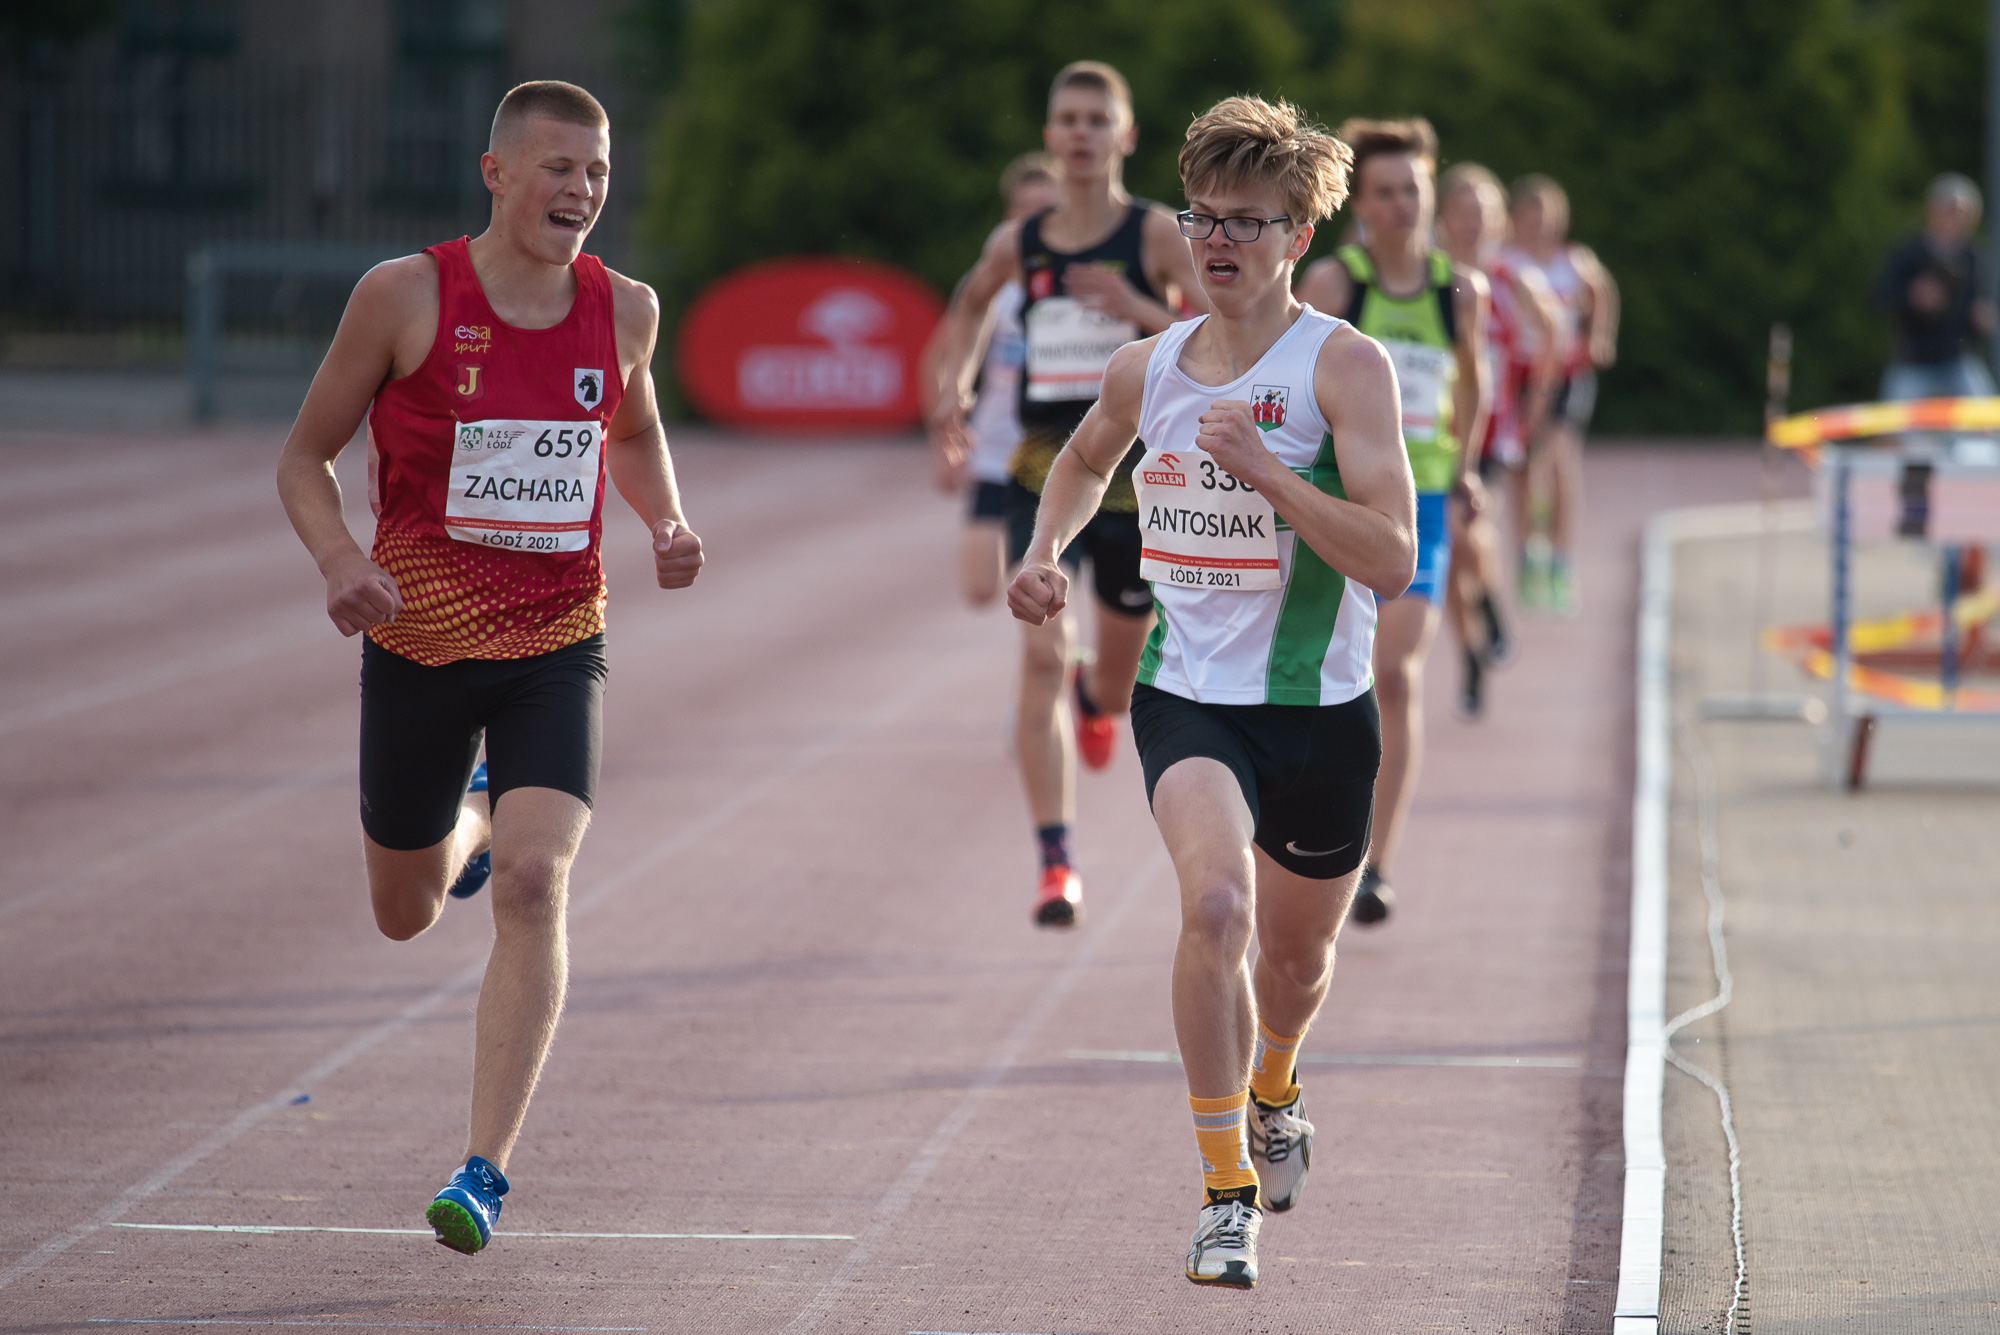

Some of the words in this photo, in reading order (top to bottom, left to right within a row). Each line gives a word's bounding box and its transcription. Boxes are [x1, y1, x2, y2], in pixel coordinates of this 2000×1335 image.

[455, 325, 491, 340] esa
[458, 367, 480, 395] J
[487, 437, 512, 449] ŁÓDŹ
[534, 429, 593, 458] 659
[463, 475, 584, 502] ZACHARA
[1146, 473, 1184, 486] ORLEN
[1147, 506, 1266, 538] ANTOSIAK
[482, 531, 523, 548] ŁÓDŹ
[527, 536, 559, 550] 2021
[1170, 566, 1203, 585] ŁÓDŹ
[1207, 572, 1240, 586] 2021
